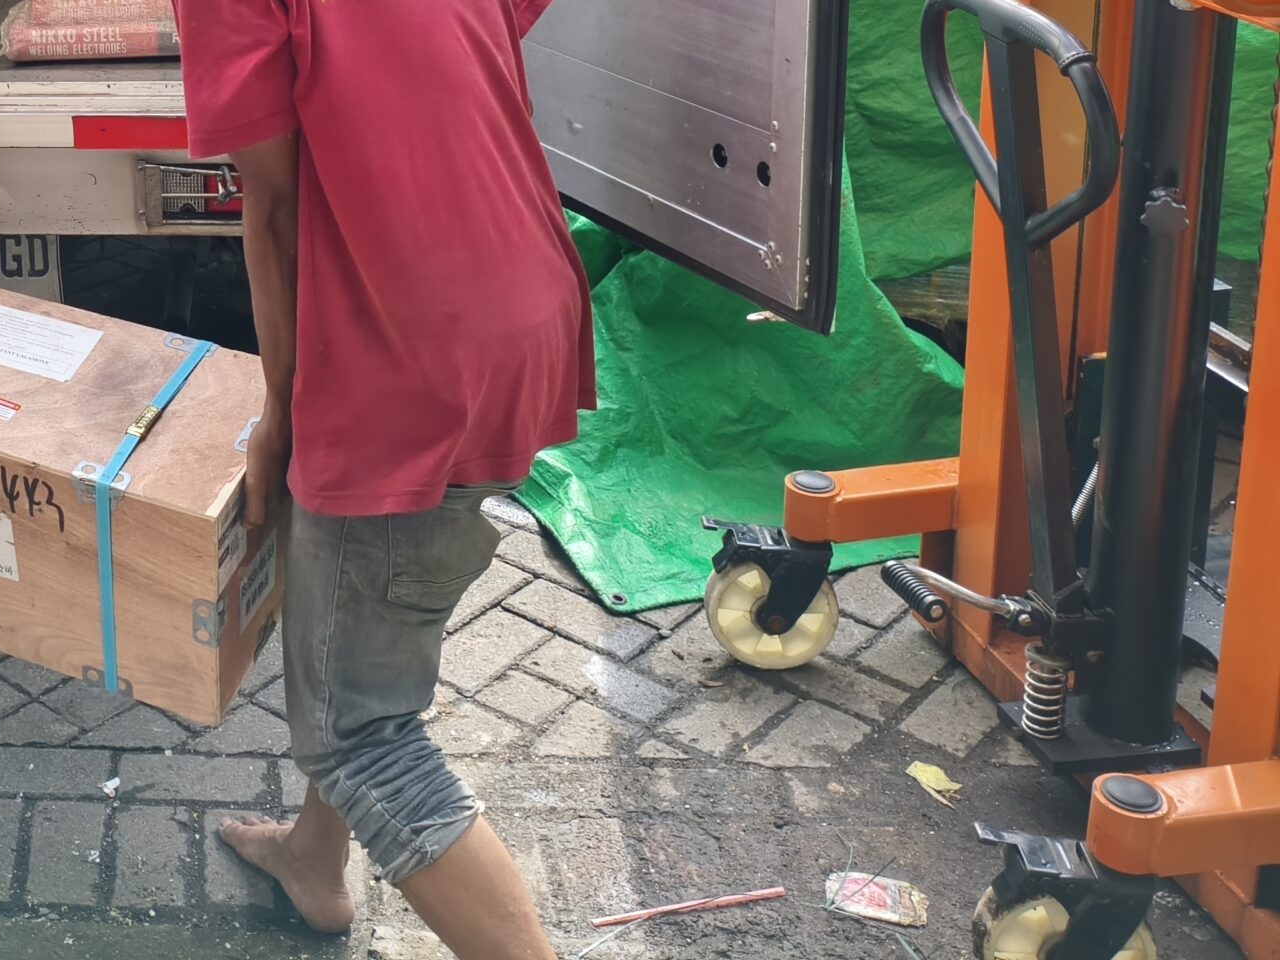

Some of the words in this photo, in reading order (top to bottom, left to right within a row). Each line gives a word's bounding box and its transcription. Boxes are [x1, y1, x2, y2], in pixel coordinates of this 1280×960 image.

[31, 28, 75, 44] NIKKO
[82, 26, 123, 42] STEEL
[28, 44, 69, 56] WELDING
[73, 42, 127, 54] ELECTRODES
[0, 234, 50, 278] GD
